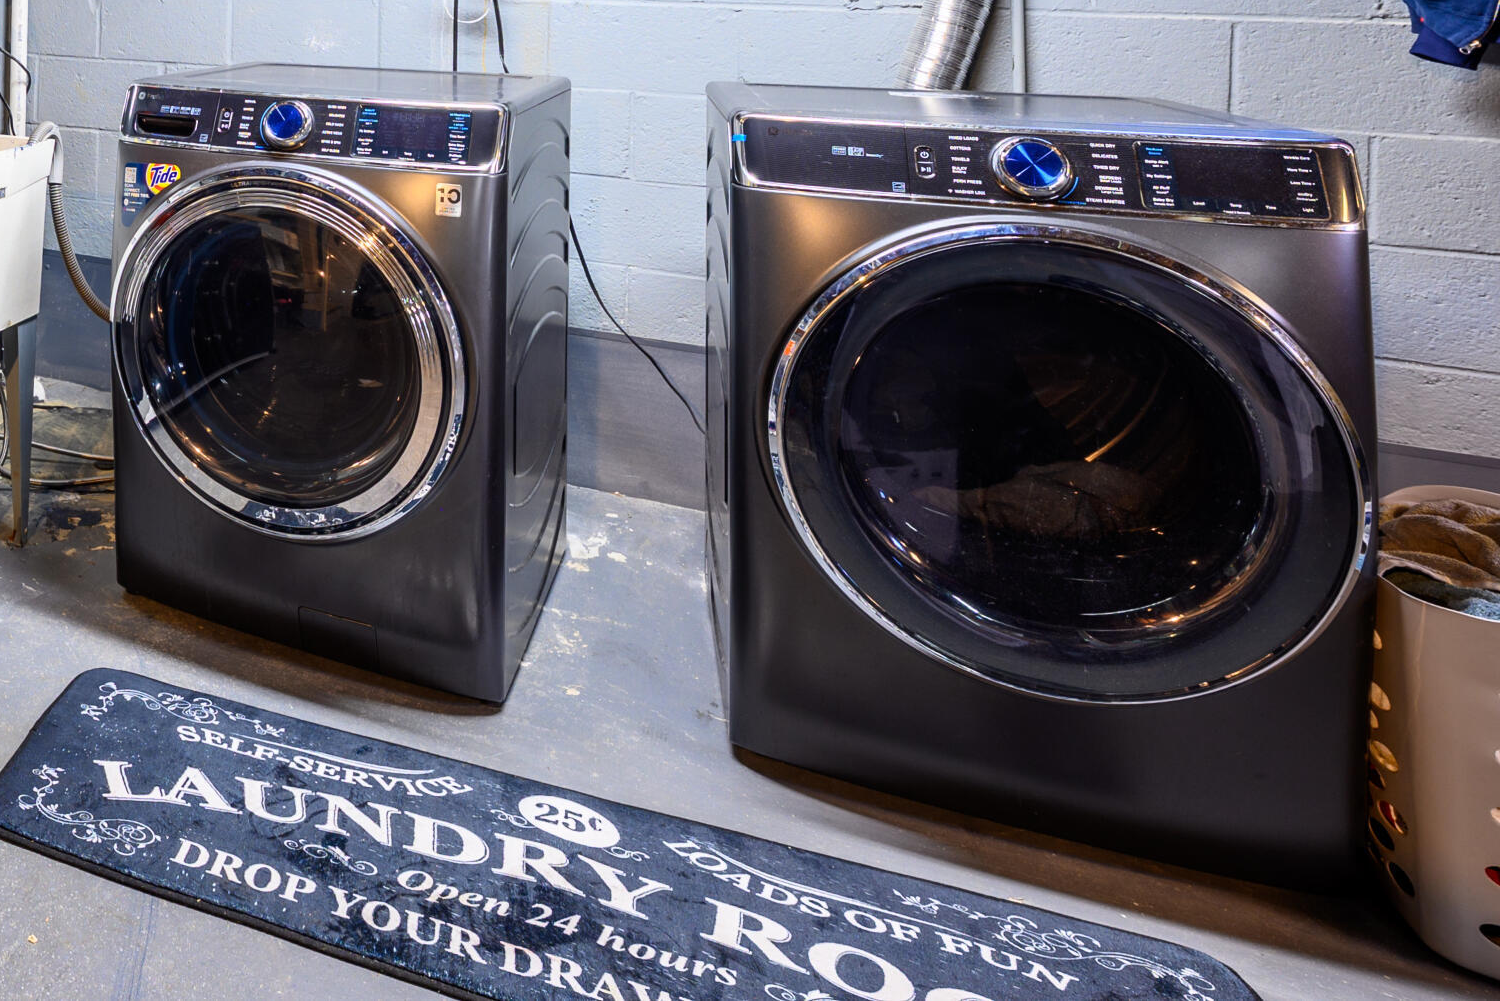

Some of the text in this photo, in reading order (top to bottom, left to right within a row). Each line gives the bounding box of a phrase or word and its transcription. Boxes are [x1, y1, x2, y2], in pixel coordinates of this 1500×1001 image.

[150, 164, 178, 187] Tide
[176, 724, 474, 798] SELF-SERVICE
[92, 759, 673, 921] LAUNDRY
[168, 837, 318, 903] DROP
[328, 884, 488, 965] YOUR
[397, 869, 739, 987] Open 24 hours
[662, 839, 1081, 993] LOADS OF FUN
